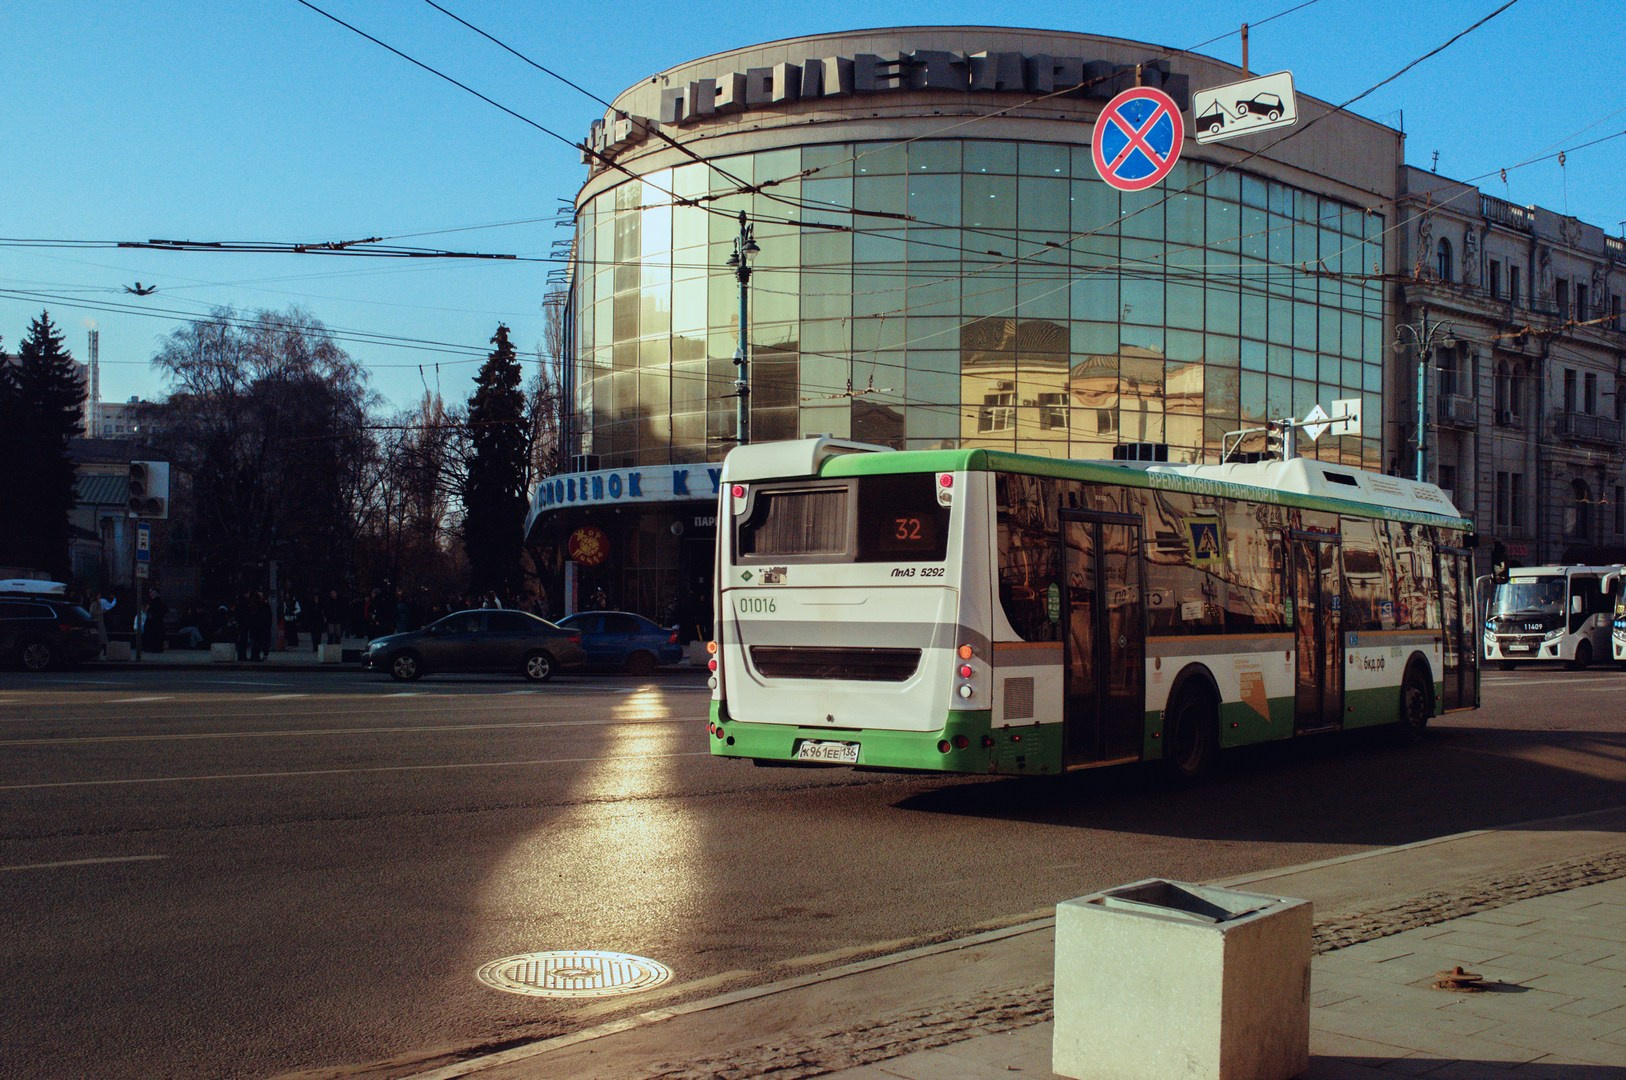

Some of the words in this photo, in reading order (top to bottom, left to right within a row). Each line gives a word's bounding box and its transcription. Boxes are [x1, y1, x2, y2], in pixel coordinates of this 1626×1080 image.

[1148, 471, 1182, 489] ВРЕМЯ
[1185, 477, 1222, 495] НОВОГО
[1225, 482, 1279, 503] ТРАНСПОРТА
[896, 519, 922, 540] 32
[920, 567, 945, 577] 5292
[740, 597, 776, 614] 01016
